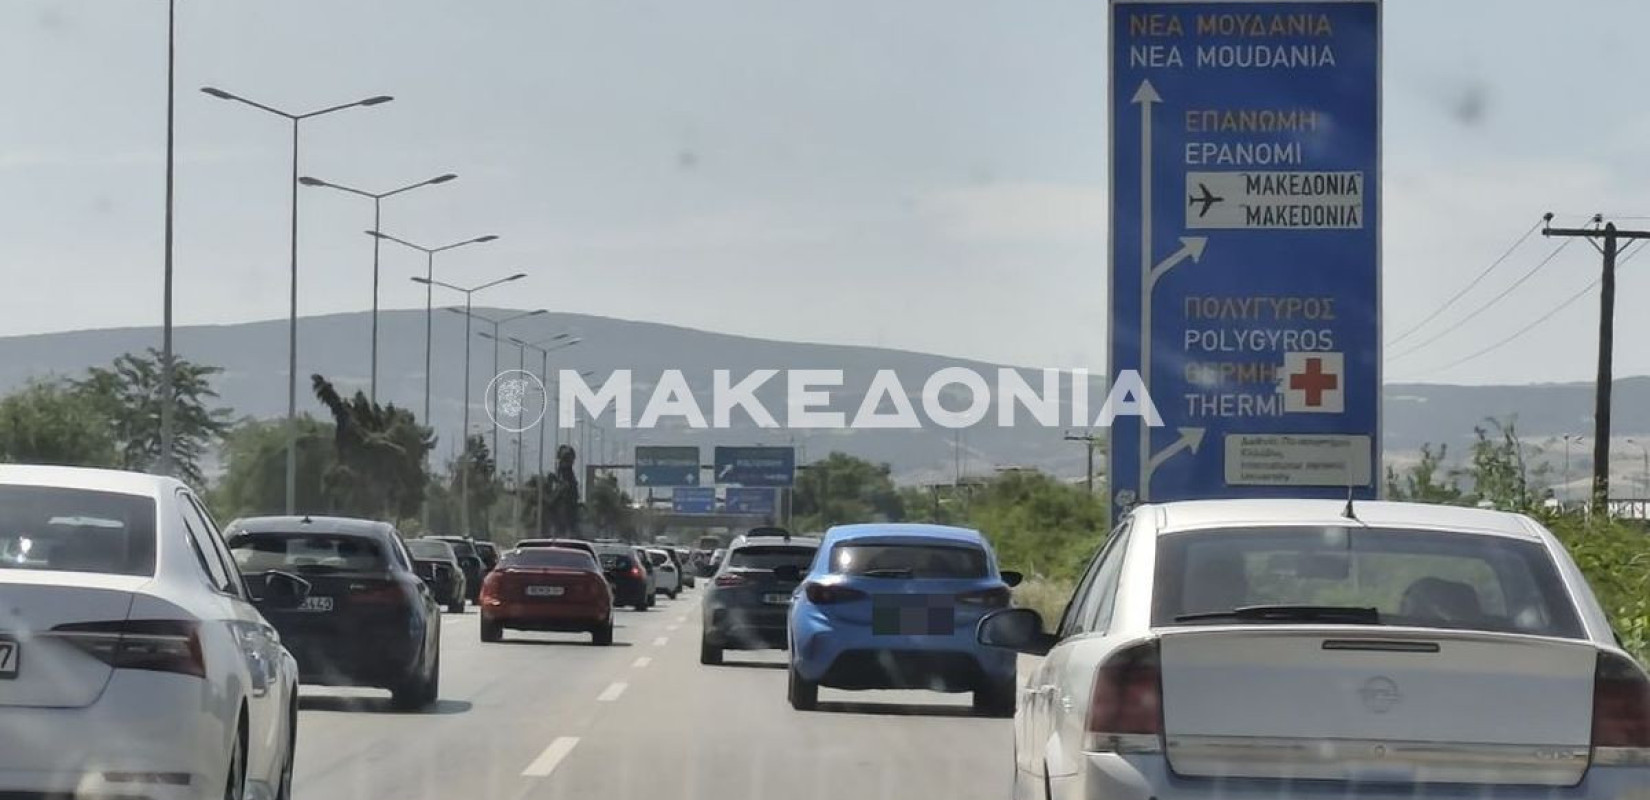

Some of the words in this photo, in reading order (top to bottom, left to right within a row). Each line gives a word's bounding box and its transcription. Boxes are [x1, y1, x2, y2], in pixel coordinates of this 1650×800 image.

[1130, 14, 1184, 37] ΝΕΑ
[1196, 14, 1333, 37] ΜΟΥΔΑΝΙΑ
[1130, 45, 1183, 68] NEA
[1196, 45, 1336, 68] MOUDANIA
[1186, 110, 1317, 132] ΕΠΑΝΩΜΗ
[1185, 142, 1302, 165] EPANOMI
[1184, 296, 1336, 320] ΠΟΛΥΓΥΡΟΣ
[1184, 329, 1334, 351] POLYGYROS
[1184, 392, 1284, 417] THERMI
